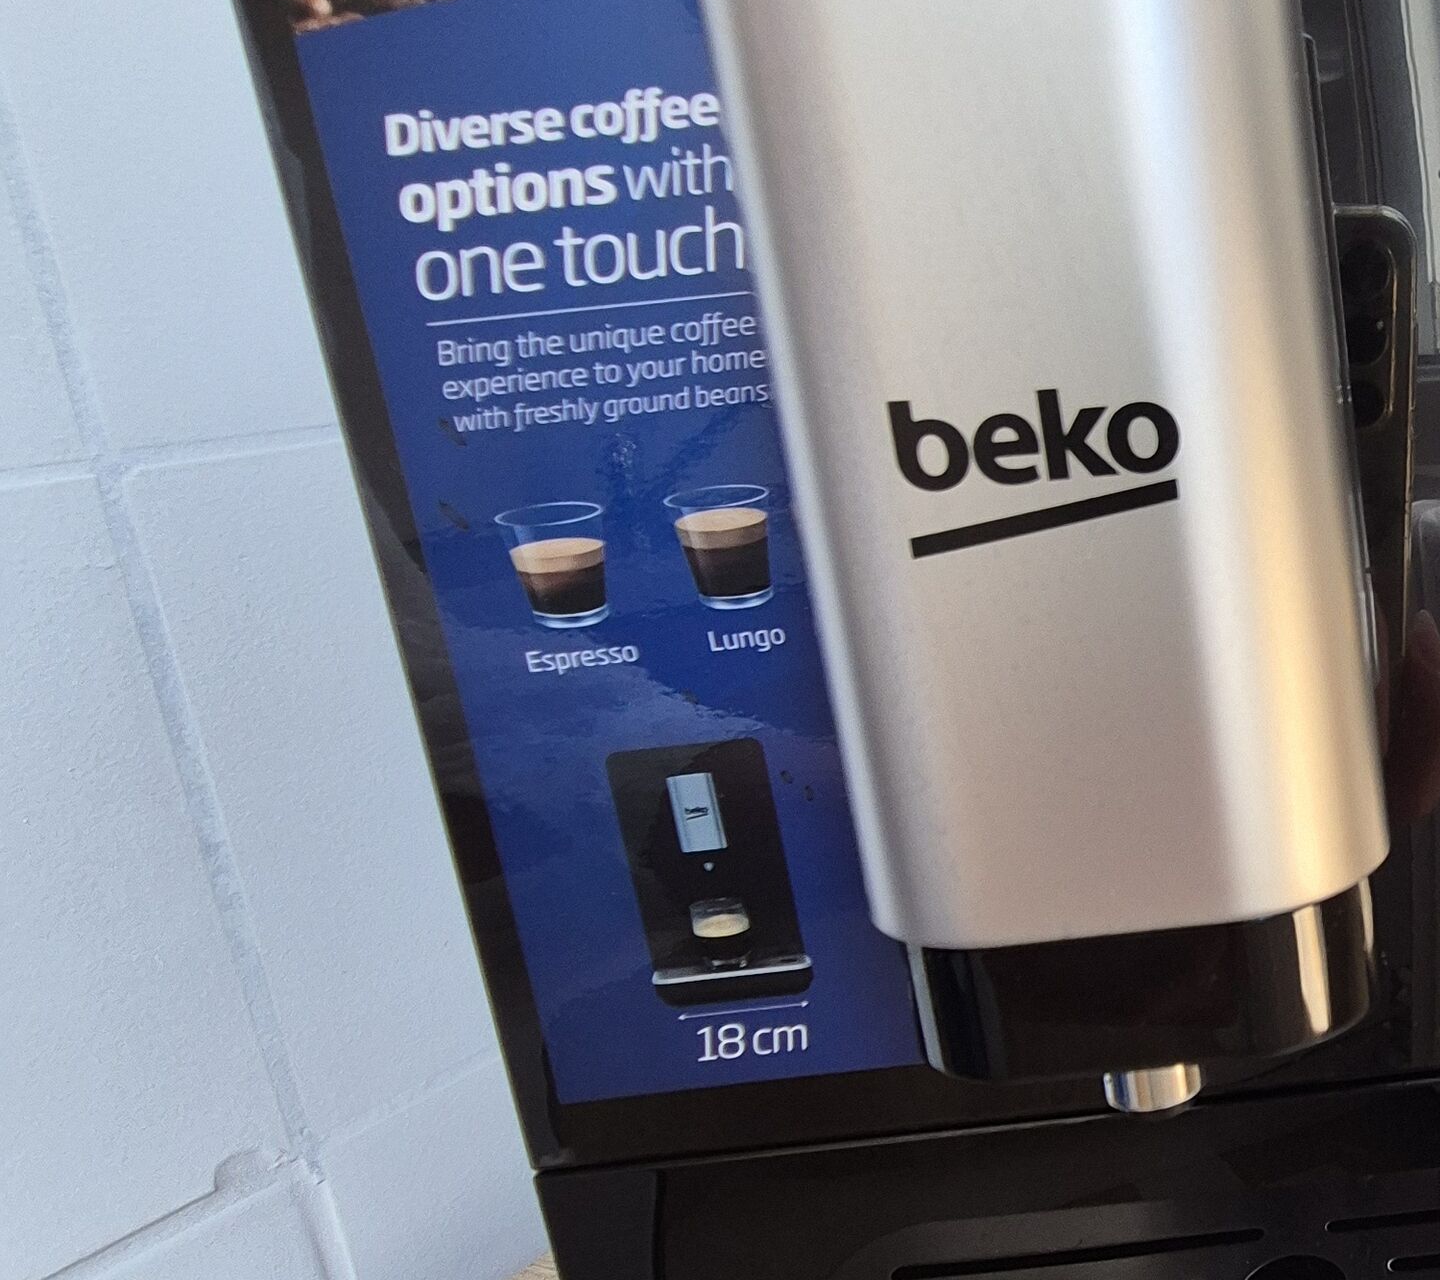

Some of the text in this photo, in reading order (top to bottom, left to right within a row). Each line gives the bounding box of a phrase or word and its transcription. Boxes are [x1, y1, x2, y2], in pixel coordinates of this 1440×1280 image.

[384, 86, 721, 156] Diverse coffee
[399, 143, 733, 232] options with
[415, 205, 745, 301] one touch
[437, 311, 756, 367] Bring the unique coffee
[442, 349, 766, 402] experience to your home
[453, 384, 769, 432] with freshly ground beans
[887, 388, 1181, 492] beko
[525, 644, 640, 674] Espresso
[708, 627, 786, 653] Lungo
[696, 1022, 809, 1063] 18 cm
